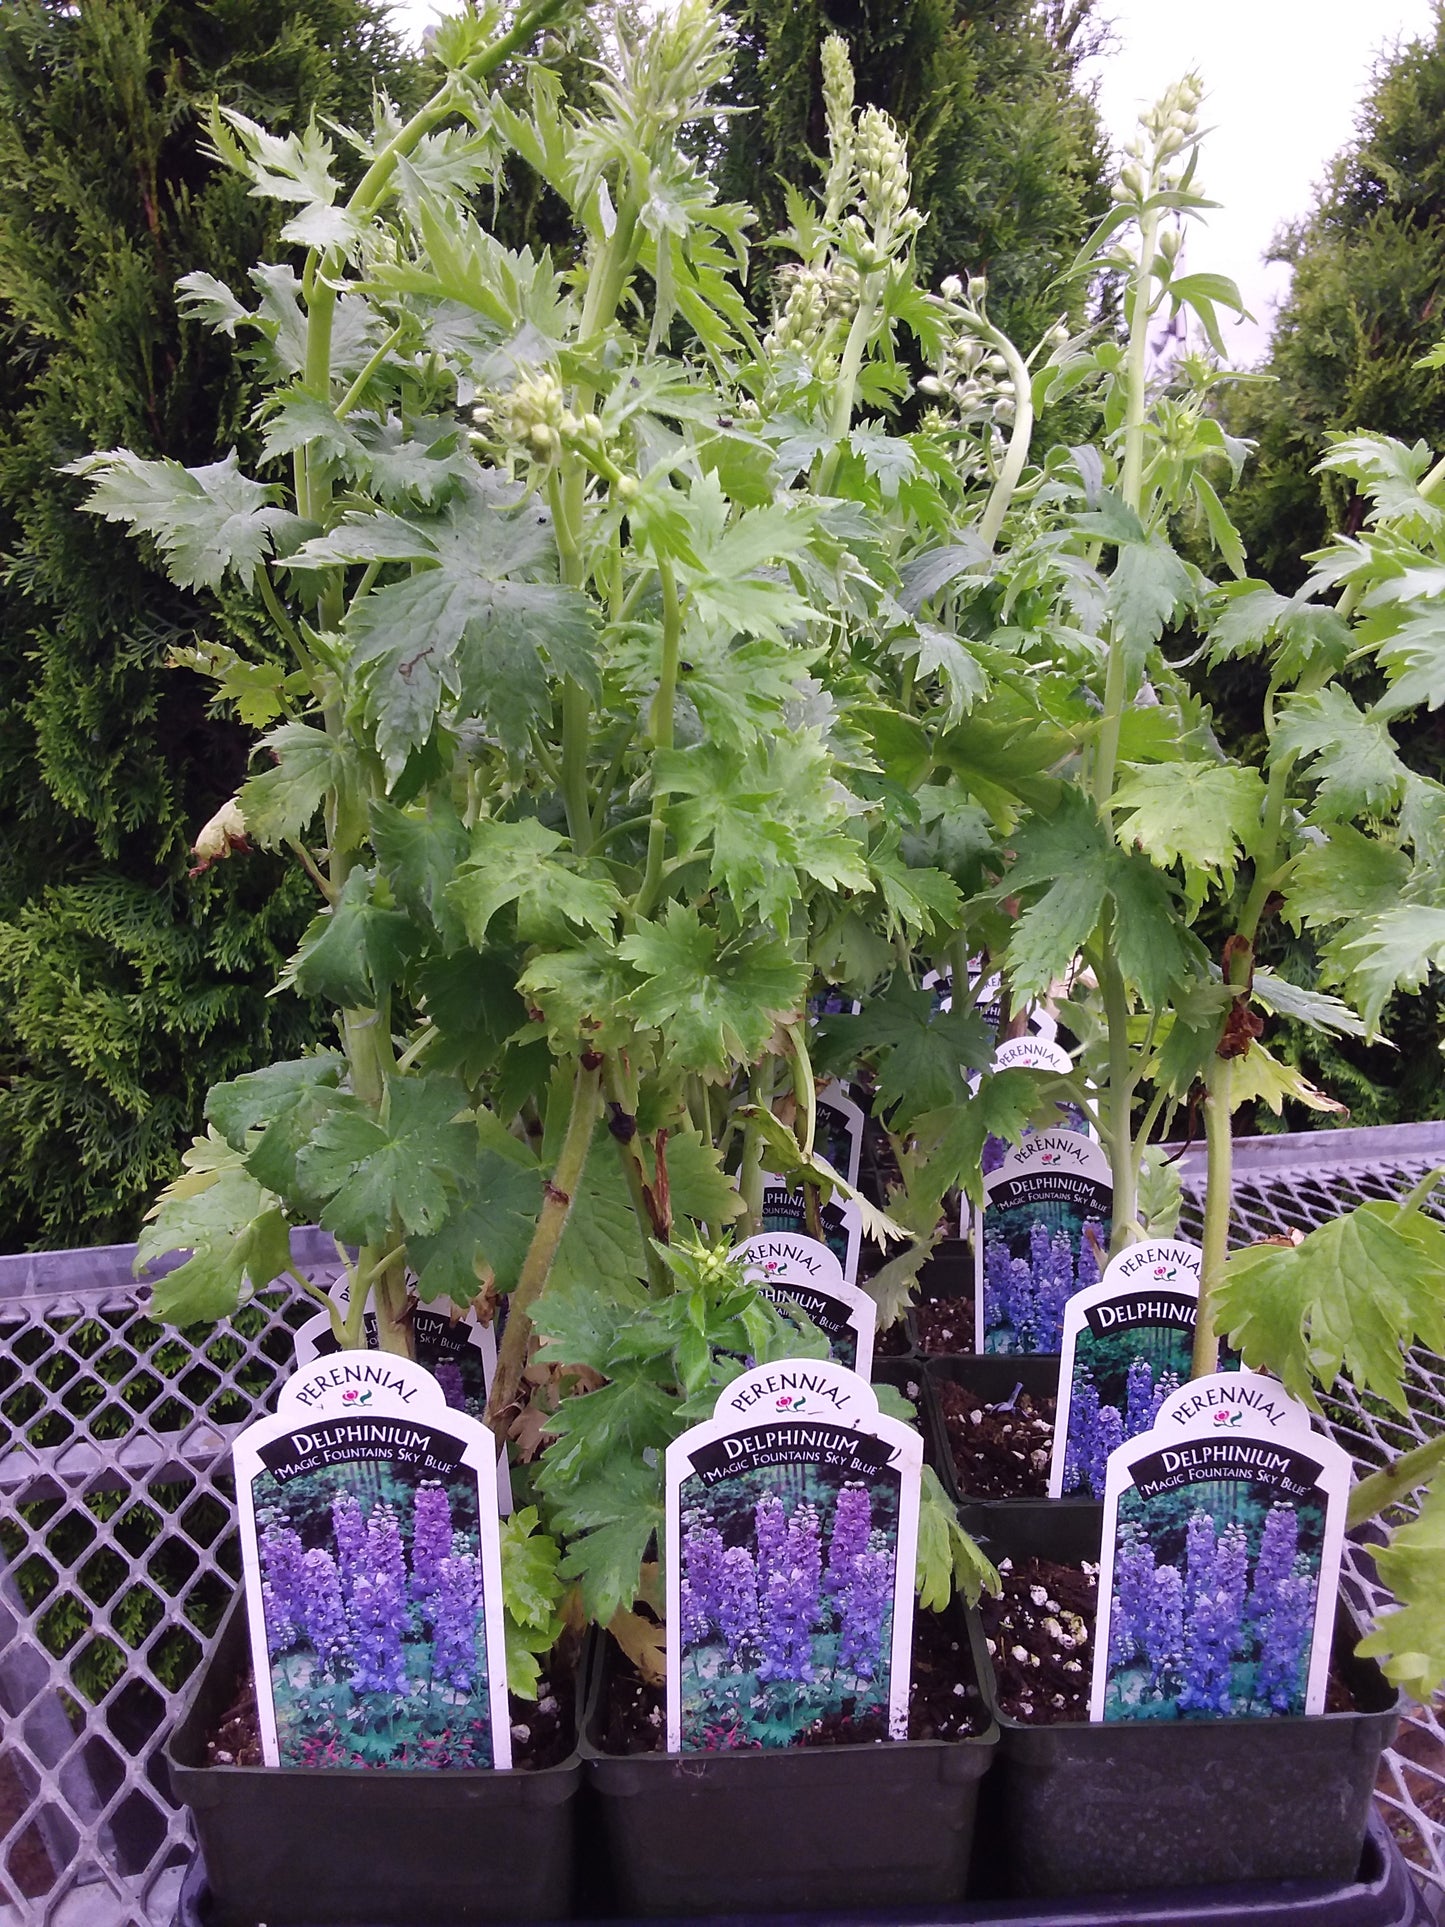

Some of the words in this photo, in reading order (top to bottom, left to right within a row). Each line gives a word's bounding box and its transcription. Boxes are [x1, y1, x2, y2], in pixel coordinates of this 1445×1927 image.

[999, 1044, 1061, 1068] PERENNIAL
[1013, 1136, 1089, 1165] PERENNIAL
[1009, 1177, 1096, 1197] DELPHINIUM
[1027, 1190, 1072, 1201] FOUNTAINS
[1073, 1192, 1089, 1205] SKY
[763, 1207, 800, 1217] OUNTAINS
[738, 1243, 822, 1276] RENNIAL
[1119, 1248, 1201, 1281] PERENNIA
[420, 1333, 437, 1344] SKY
[295, 1365, 419, 1407] PERENNIAL
[730, 1373, 852, 1413] PERENNIAL
[1171, 1387, 1287, 1427] PERENNIAL
[291, 1424, 432, 1455] DELPHINIUM
[722, 1429, 860, 1459] DELPHINIUM
[323, 1447, 393, 1463] FOUNTAINS
[397, 1448, 421, 1463] SKY
[752, 1450, 821, 1466] FOUNTAINS
[824, 1450, 847, 1465] SKY
[1161, 1445, 1291, 1473] DELPHINIUM
[1188, 1466, 1253, 1481] FOUNTAINS
[1257, 1468, 1279, 1485] SKY
